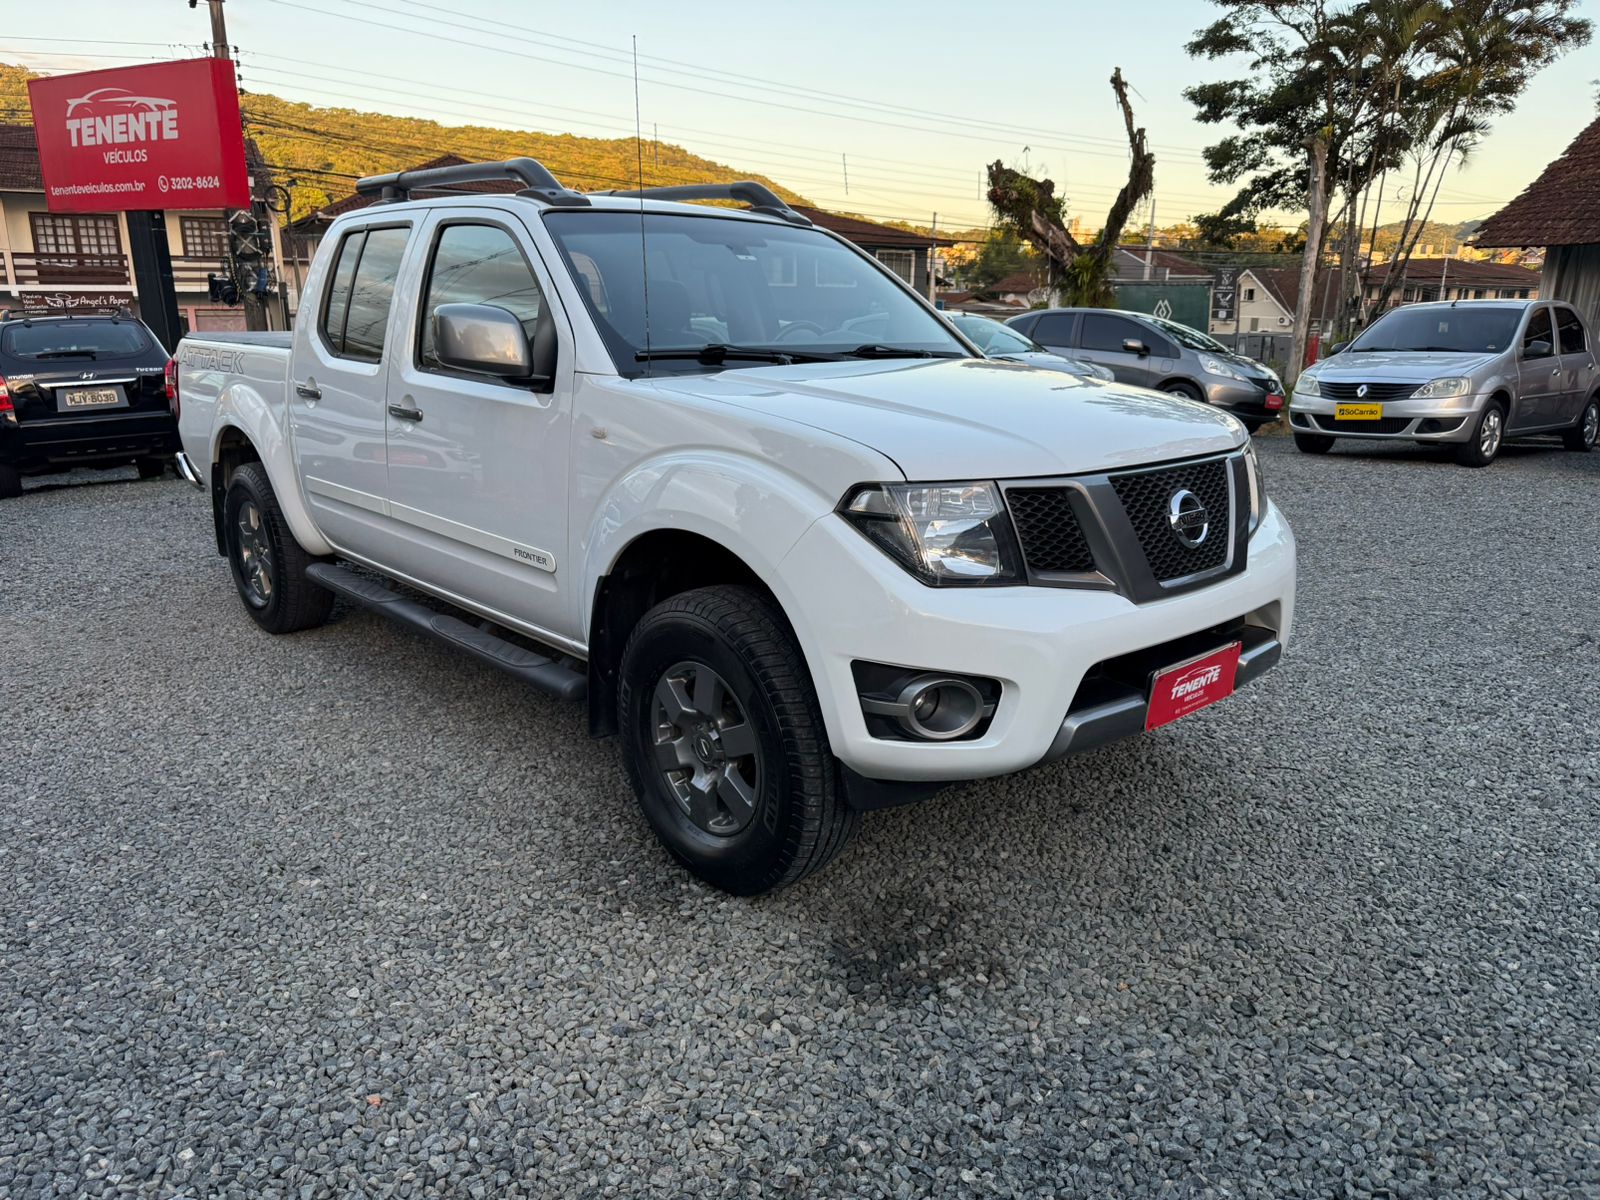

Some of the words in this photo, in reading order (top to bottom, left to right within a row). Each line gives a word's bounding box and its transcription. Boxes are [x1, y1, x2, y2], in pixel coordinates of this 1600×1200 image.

[66, 109, 179, 147] TENENTE
[103, 148, 148, 165] VEÍCULOS
[51, 180, 146, 197] tenenteveiculos.com.br
[170, 175, 220, 190] 3202-8624
[80, 296, 107, 307] Angel's
[109, 296, 131, 307] Paper
[179, 345, 245, 375] ATTACK
[514, 548, 548, 566] FRONTIER
[1170, 668, 1221, 700] TENENTE
